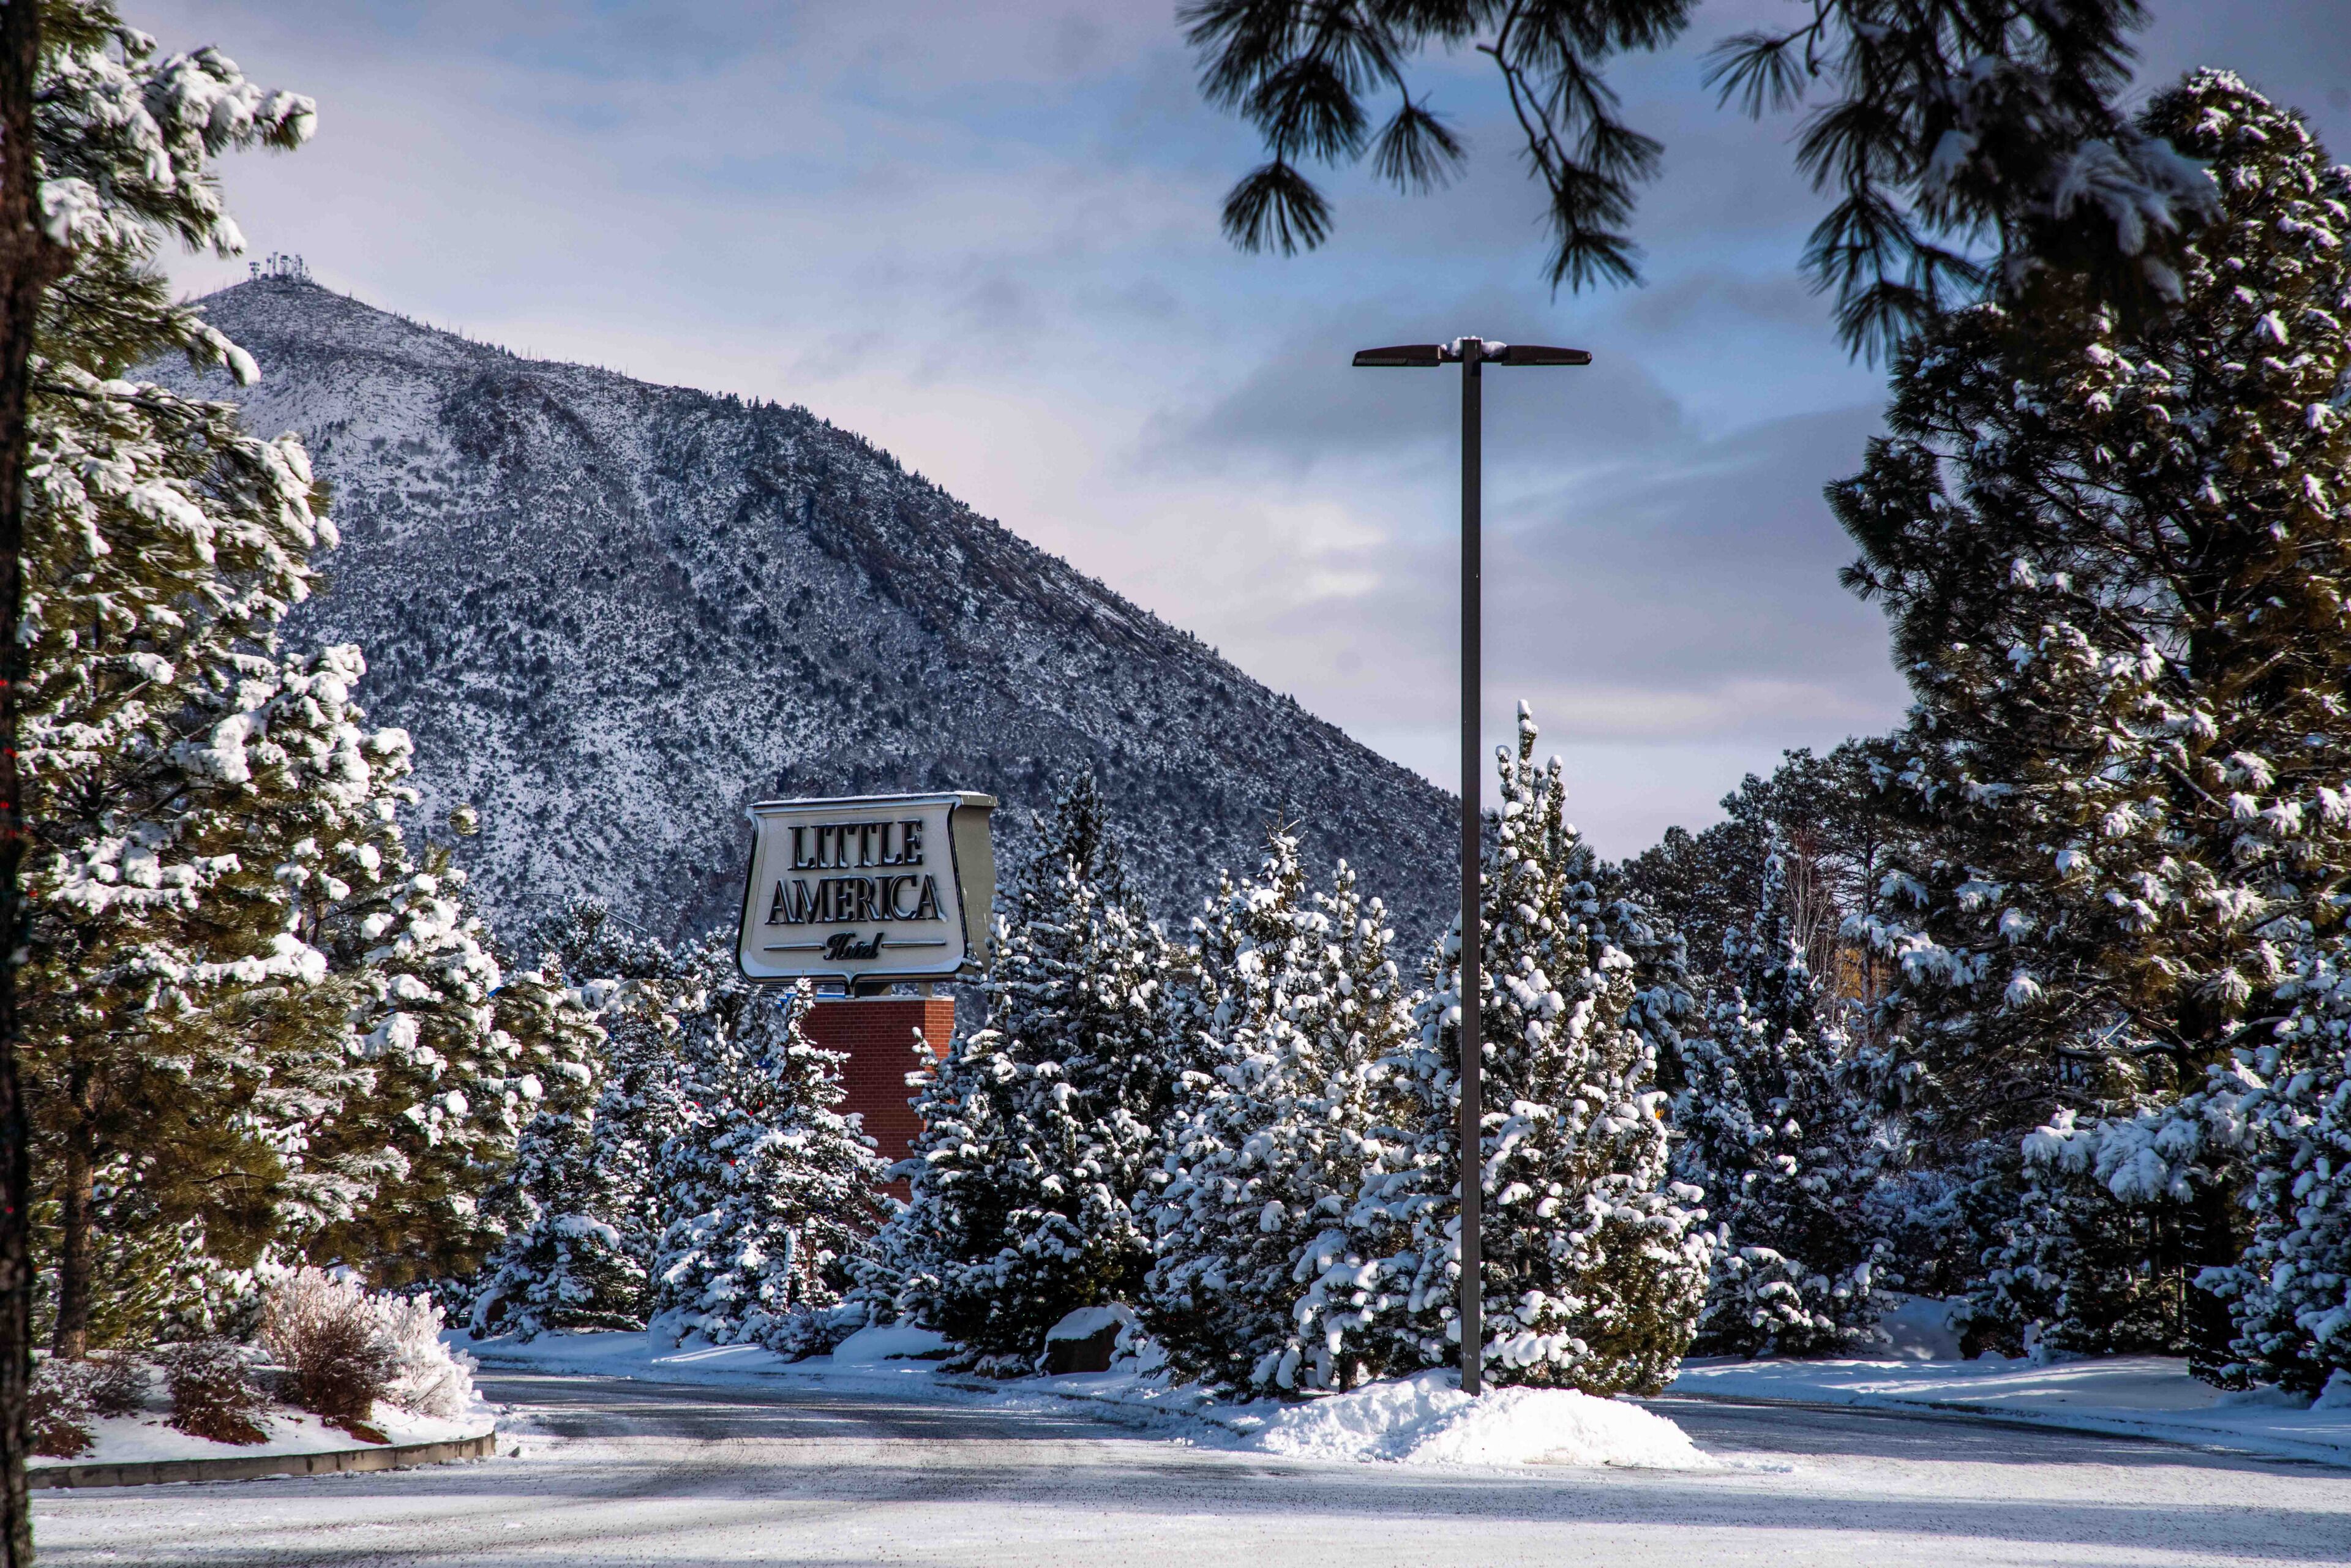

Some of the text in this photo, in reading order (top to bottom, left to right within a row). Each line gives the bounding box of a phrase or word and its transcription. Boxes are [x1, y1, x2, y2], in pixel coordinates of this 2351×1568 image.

[787, 820, 923, 871] LITTLE
[765, 872, 946, 925] AMERICA
[823, 932, 884, 961] Hotel
